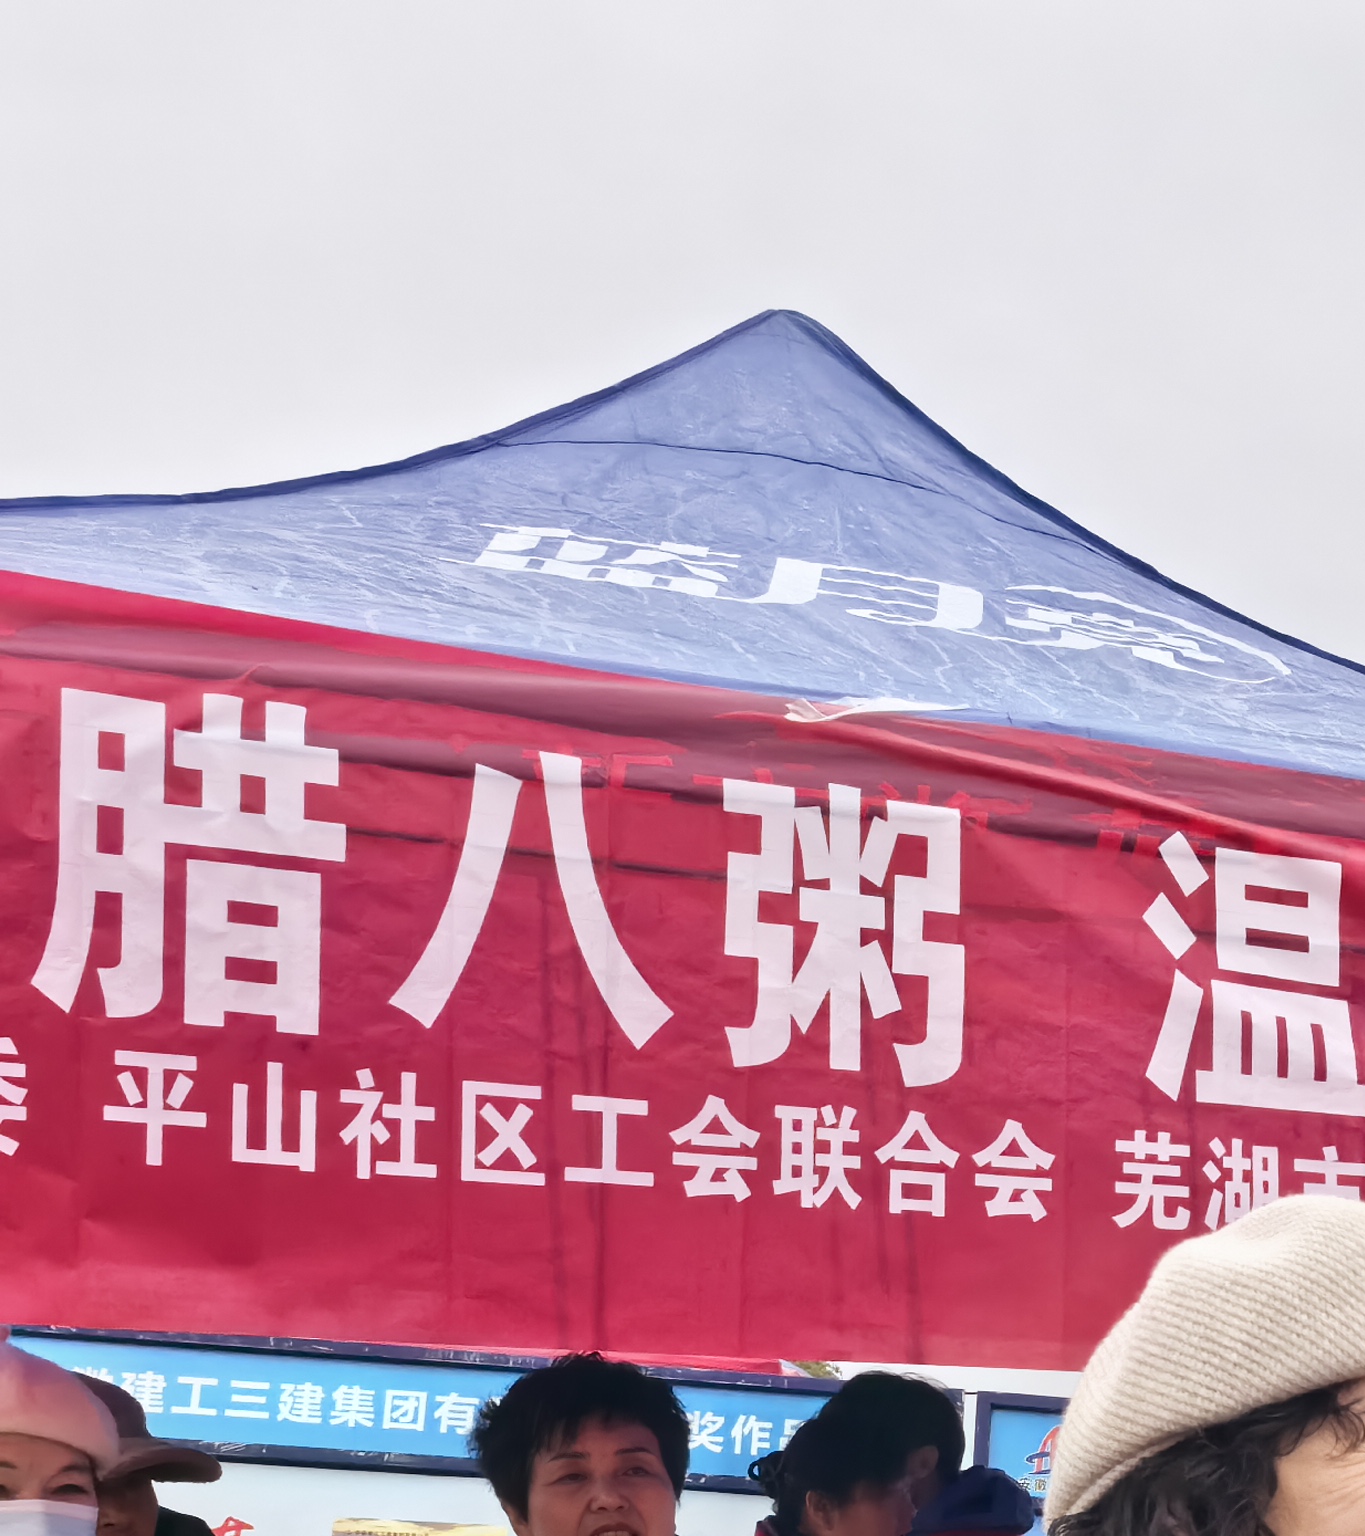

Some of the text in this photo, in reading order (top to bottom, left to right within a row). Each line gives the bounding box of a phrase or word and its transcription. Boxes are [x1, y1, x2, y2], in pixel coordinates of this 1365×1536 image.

[30, 686, 966, 1087] 腊八粥
[103, 1049, 1057, 1221] 平山社区工会联合会
[73, 1365, 502, 1436] 建工三建集团有
